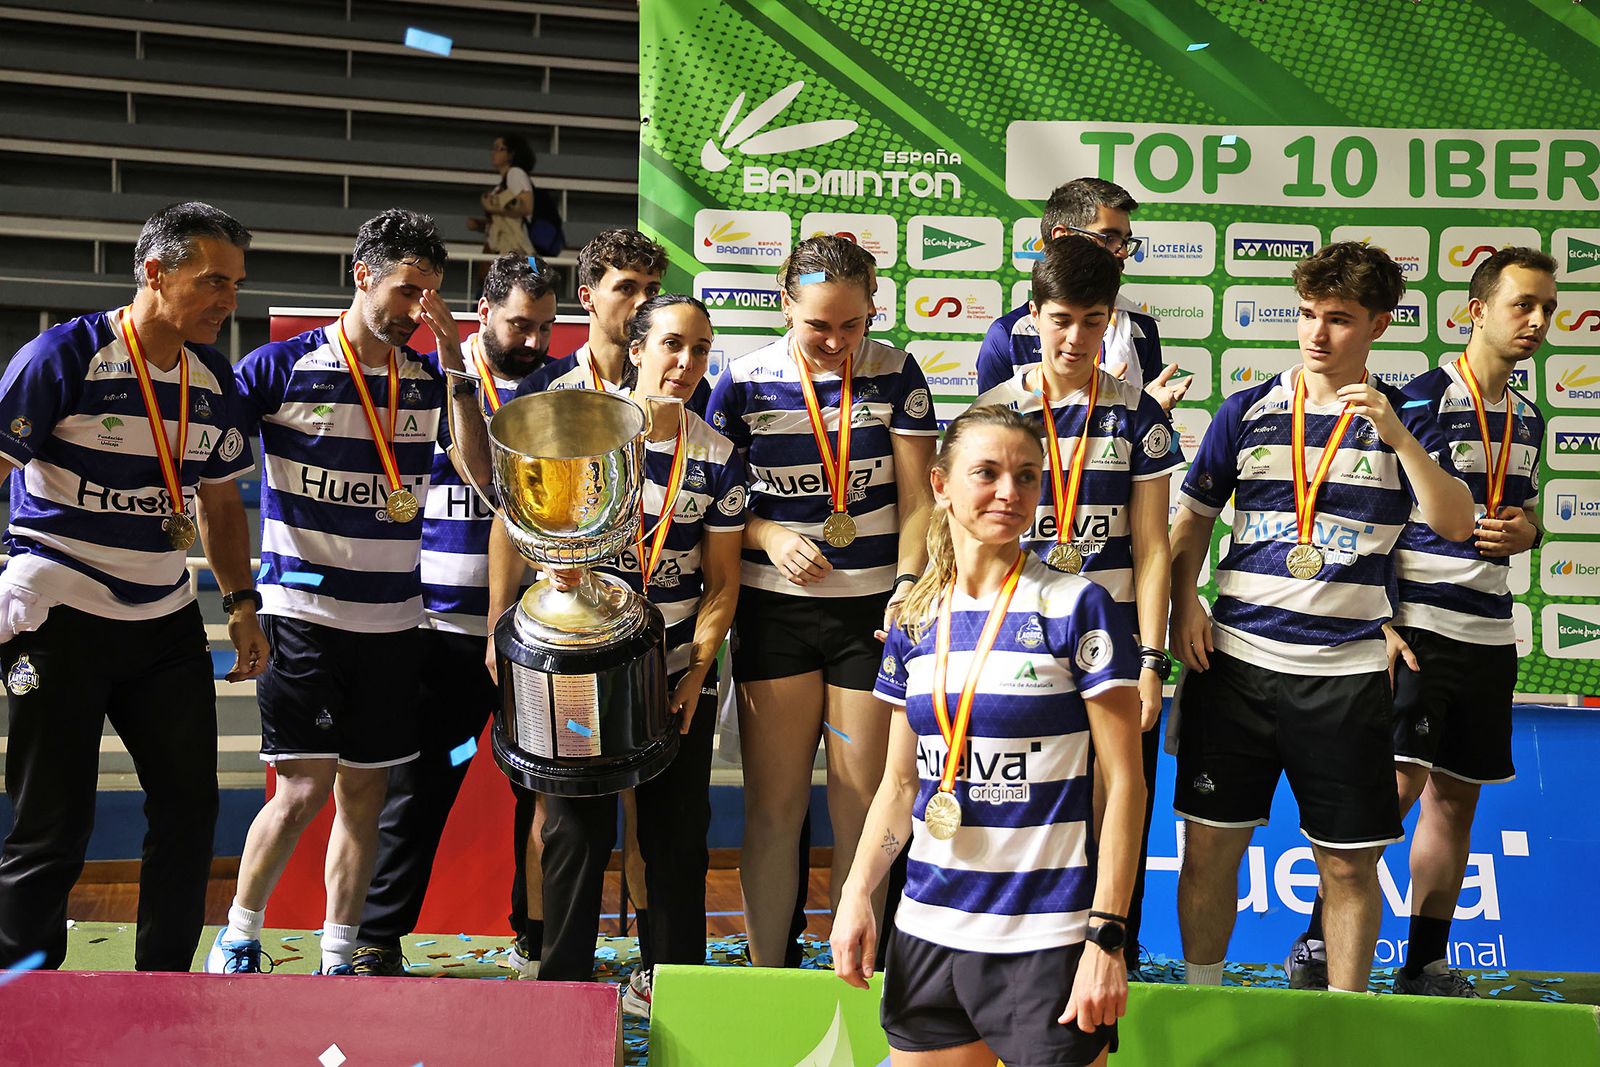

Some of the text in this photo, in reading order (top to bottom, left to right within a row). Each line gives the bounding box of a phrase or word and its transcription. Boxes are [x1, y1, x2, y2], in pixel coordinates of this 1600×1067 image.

[883, 149, 962, 165] ESPAÑA
[1079, 131, 1600, 201] TOP 10 IBER
[743, 166, 961, 198] BADMINTON
[716, 245, 782, 256] BADMINTON
[1152, 243, 1203, 253] LOTERÍAS
[1265, 243, 1309, 258] YONEX
[733, 292, 777, 308] YONEX
[1150, 306, 1204, 318] Iberdrola
[1258, 307, 1301, 317] LOTERÍA
[301, 466, 413, 505] Huelv
[756, 464, 873, 495] Huela
[77, 476, 195, 516] Huel
[1022, 515, 1110, 539] ueva
[1240, 512, 1360, 550] Hueva
[970, 784, 1028, 802] original
[1145, 820, 1501, 921] ueva
[1374, 934, 1507, 968] orinal
